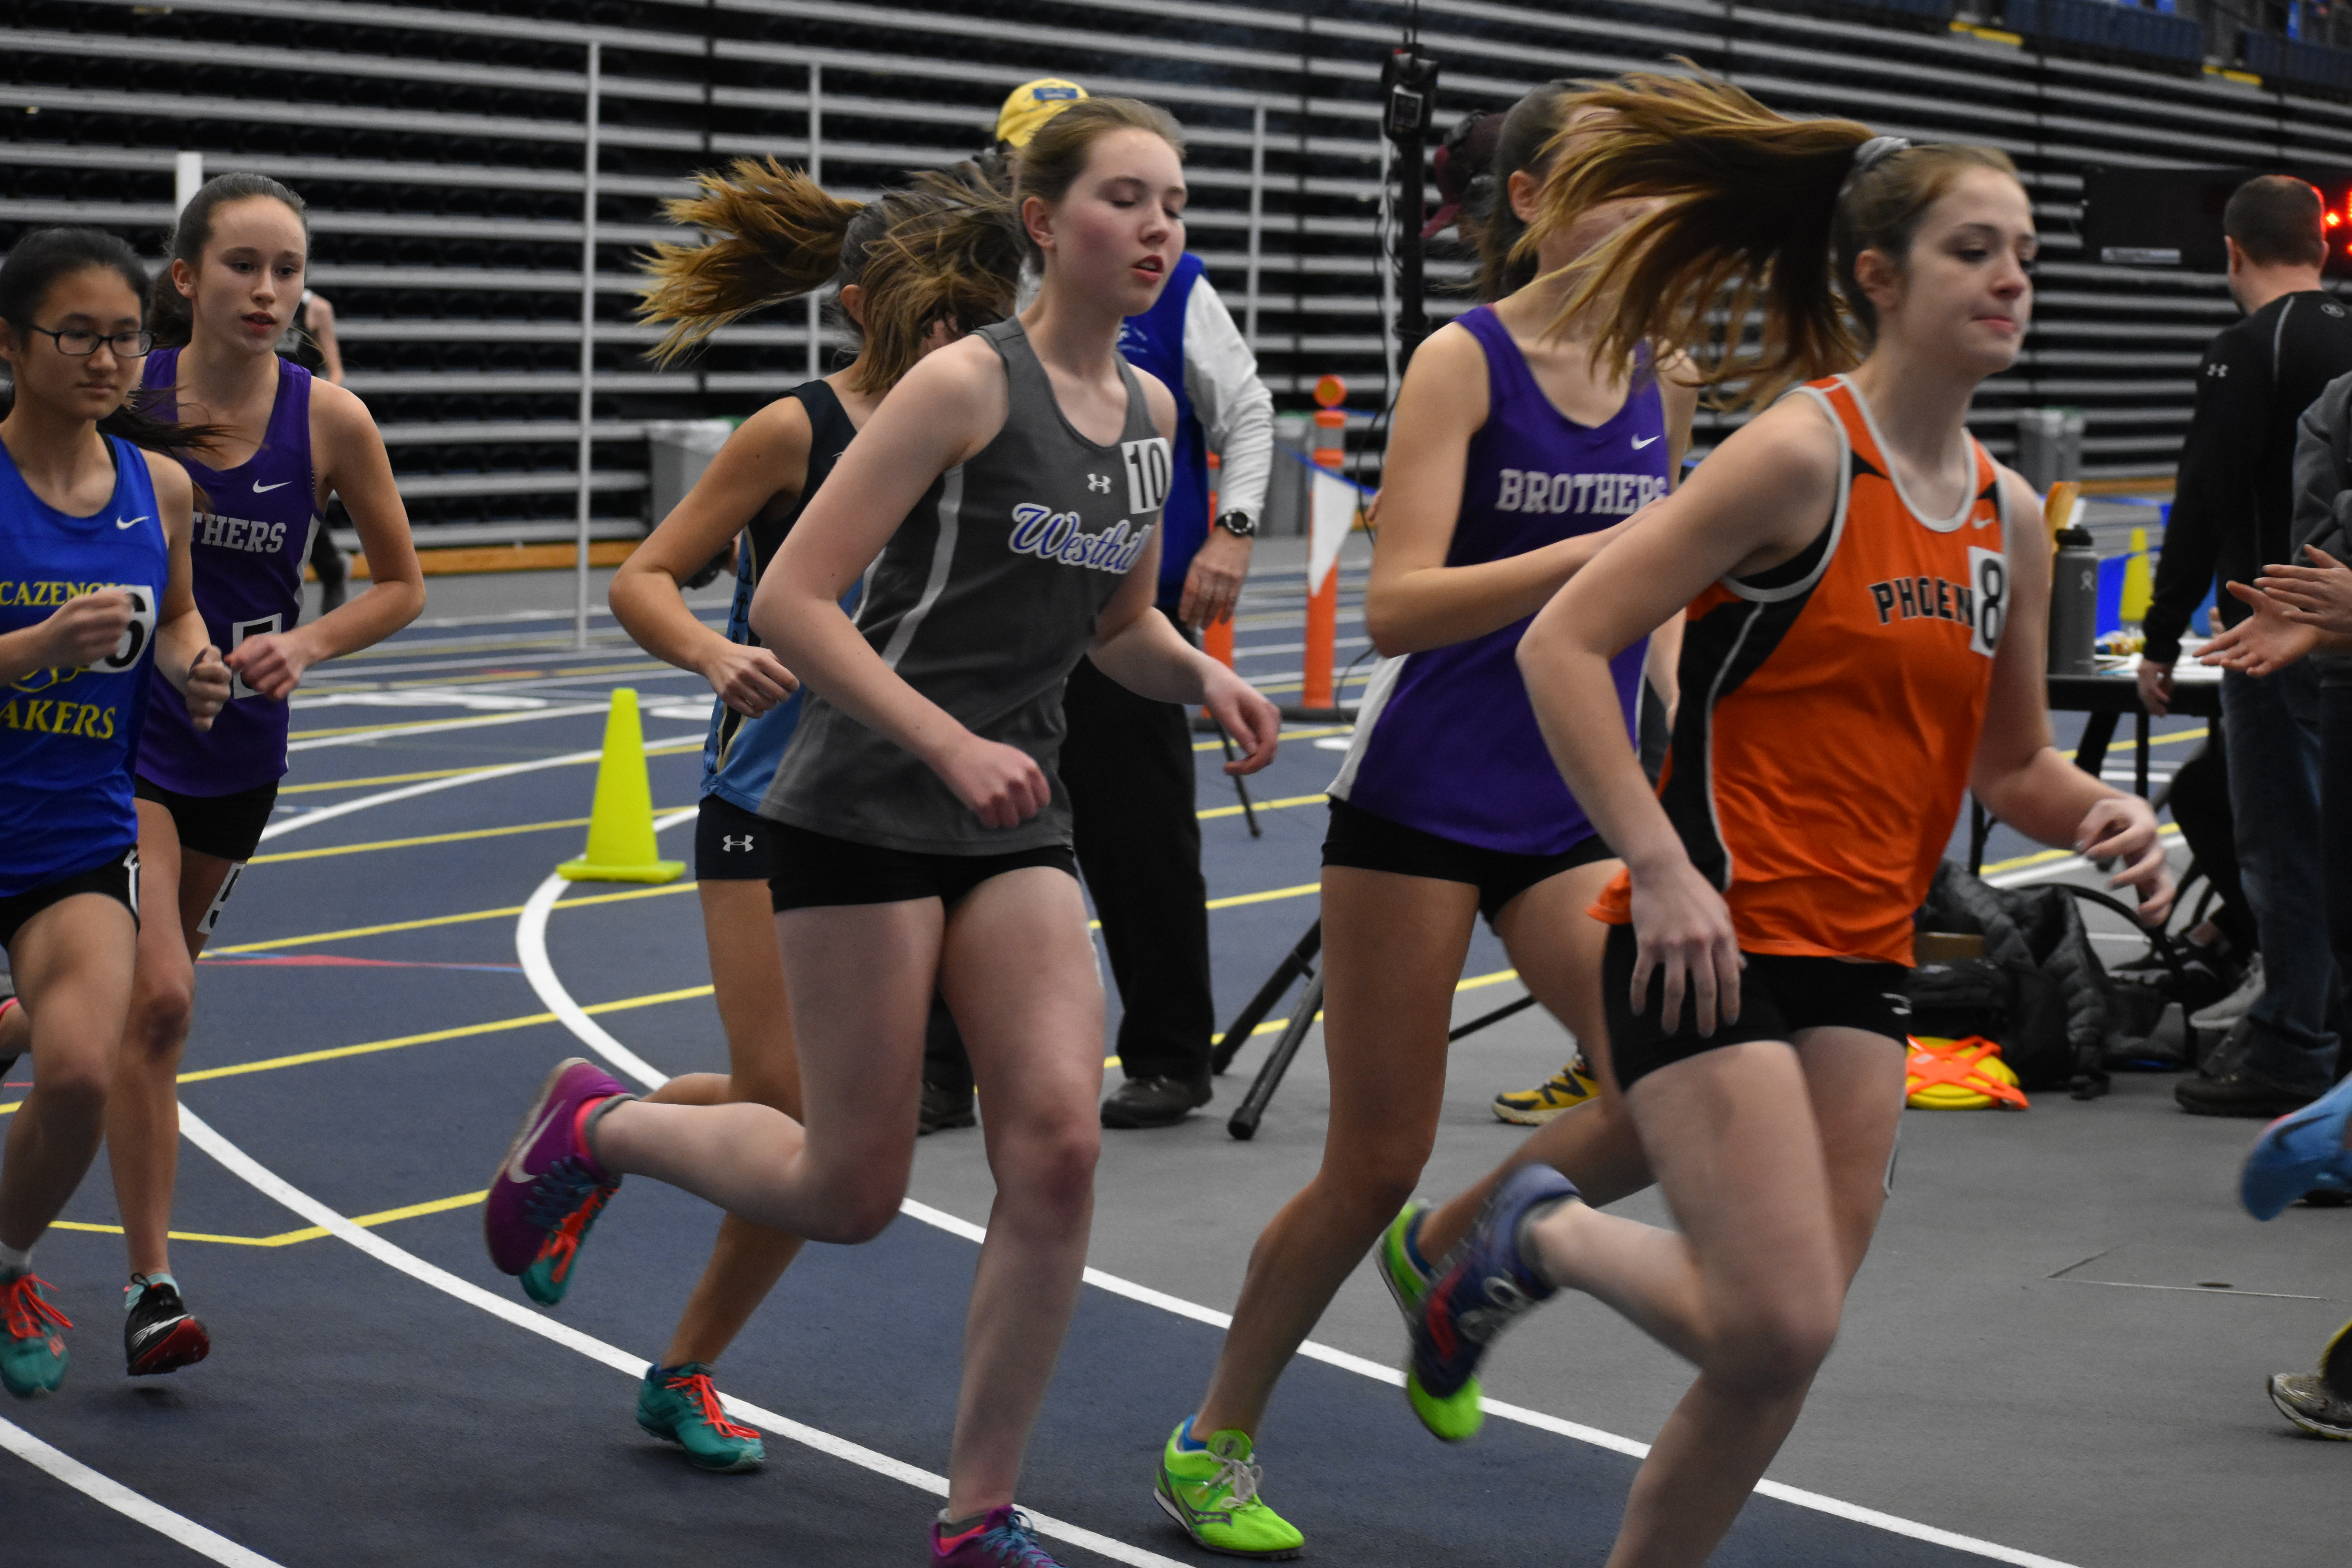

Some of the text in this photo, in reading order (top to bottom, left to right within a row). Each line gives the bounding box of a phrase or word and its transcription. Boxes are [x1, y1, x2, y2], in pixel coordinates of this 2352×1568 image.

[1129, 442, 1167, 509] 10
[1495, 468, 1668, 515] BROTHERS
[0, 581, 125, 606] CAZEN
[1980, 559, 2002, 651] 8
[0, 699, 115, 739] AKERS
